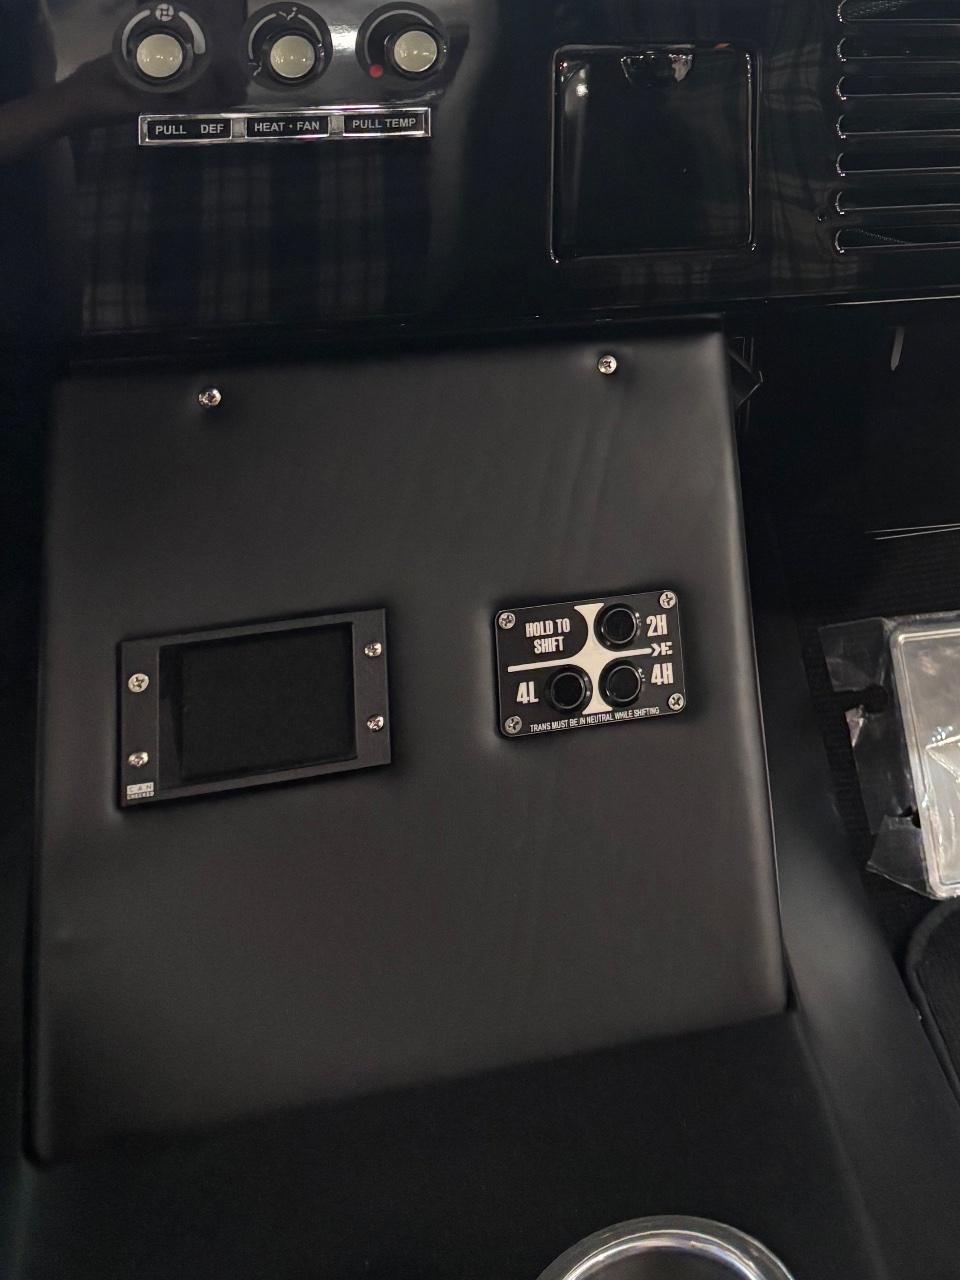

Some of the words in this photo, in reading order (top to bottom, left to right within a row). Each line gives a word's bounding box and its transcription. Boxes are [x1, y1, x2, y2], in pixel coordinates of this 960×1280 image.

[154, 124, 187, 136] PULL
[200, 123, 225, 134] DEF
[254, 122, 286, 133] HEAT
[296, 120, 320, 132] FAN
[352, 118, 382, 130] PULL
[385, 117, 417, 129] TEMP
[525, 621, 554, 638] HOLD
[555, 618, 571, 634] TO
[646, 614, 668, 637] 2H
[533, 635, 565, 655] SHIFT
[650, 662, 674, 686] 4H
[516, 681, 540, 705] 4L
[529, 721, 551, 733] TRANS
[551, 719, 570, 730] MUST
[569, 718, 579, 727] BE
[586, 713, 614, 725] NEUTRAL
[614, 710, 634, 721] WHILE
[633, 706, 660, 718] SHIFTING
[128, 784, 152, 793] CAN
